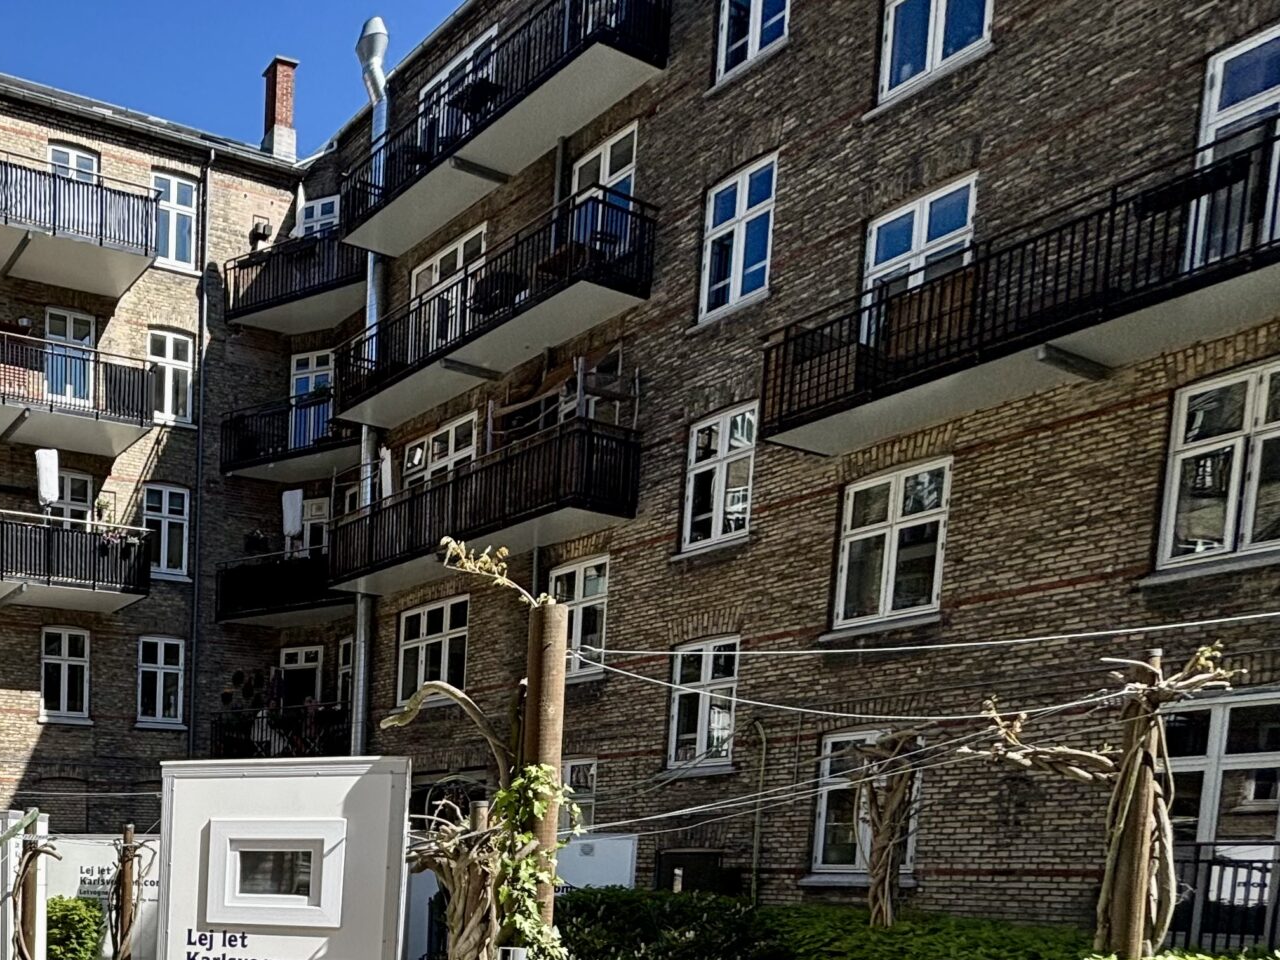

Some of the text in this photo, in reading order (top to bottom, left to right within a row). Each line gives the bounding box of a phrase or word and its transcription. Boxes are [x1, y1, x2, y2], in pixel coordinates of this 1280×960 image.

[79, 865, 111, 877] Lej let
[186, 928, 248, 952] Lej let
